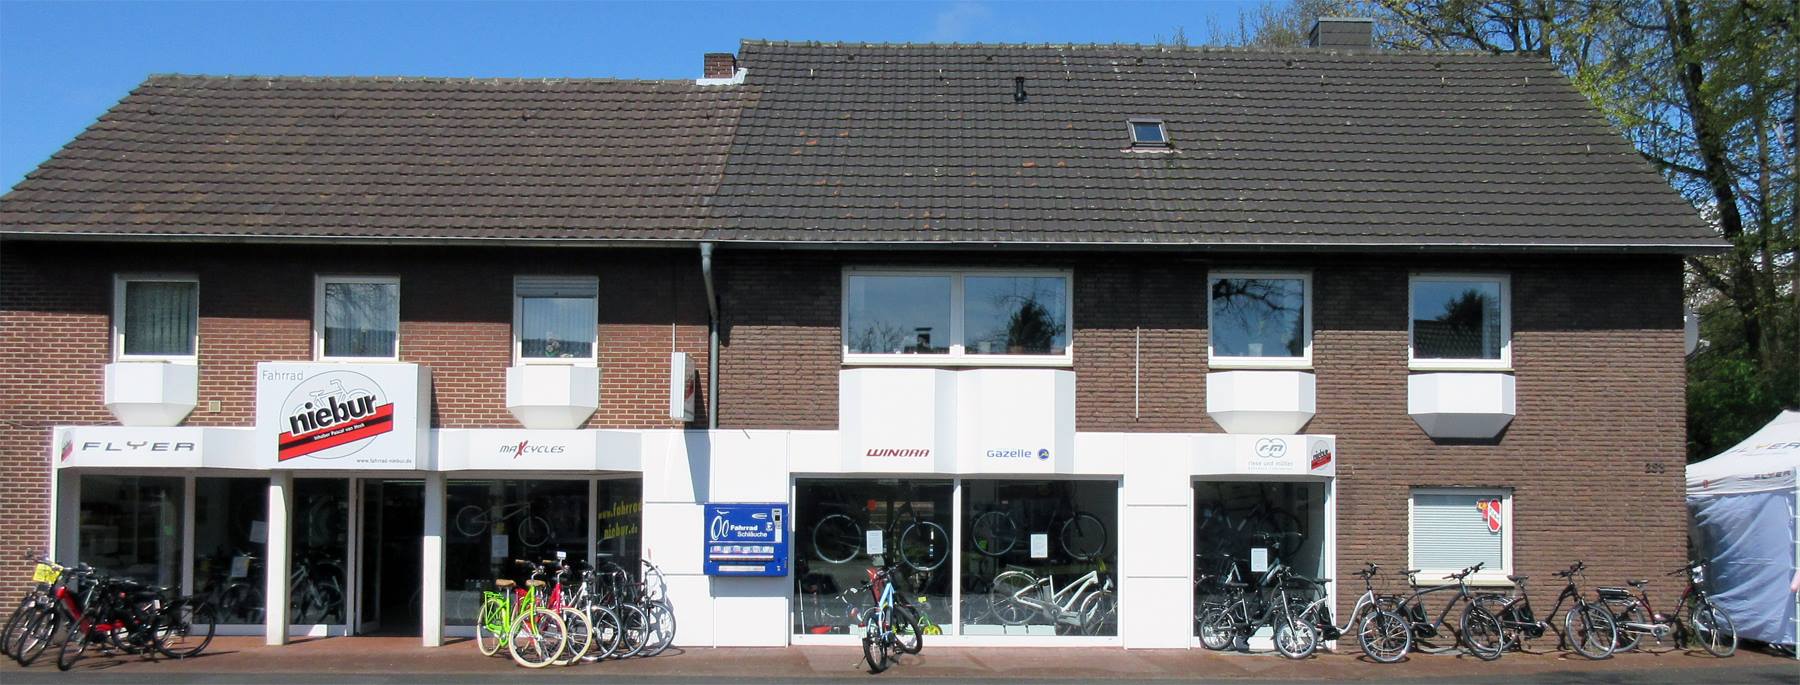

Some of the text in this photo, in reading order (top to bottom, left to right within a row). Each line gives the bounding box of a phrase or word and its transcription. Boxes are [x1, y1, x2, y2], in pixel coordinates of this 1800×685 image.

[262, 370, 304, 381] Fahrrad
[289, 394, 377, 435] niebur
[82, 441, 195, 452] FLYER
[866, 448, 929, 457] WINORA
[986, 450, 1032, 458] Gazelle
[1754, 470, 1791, 480] FLYER
